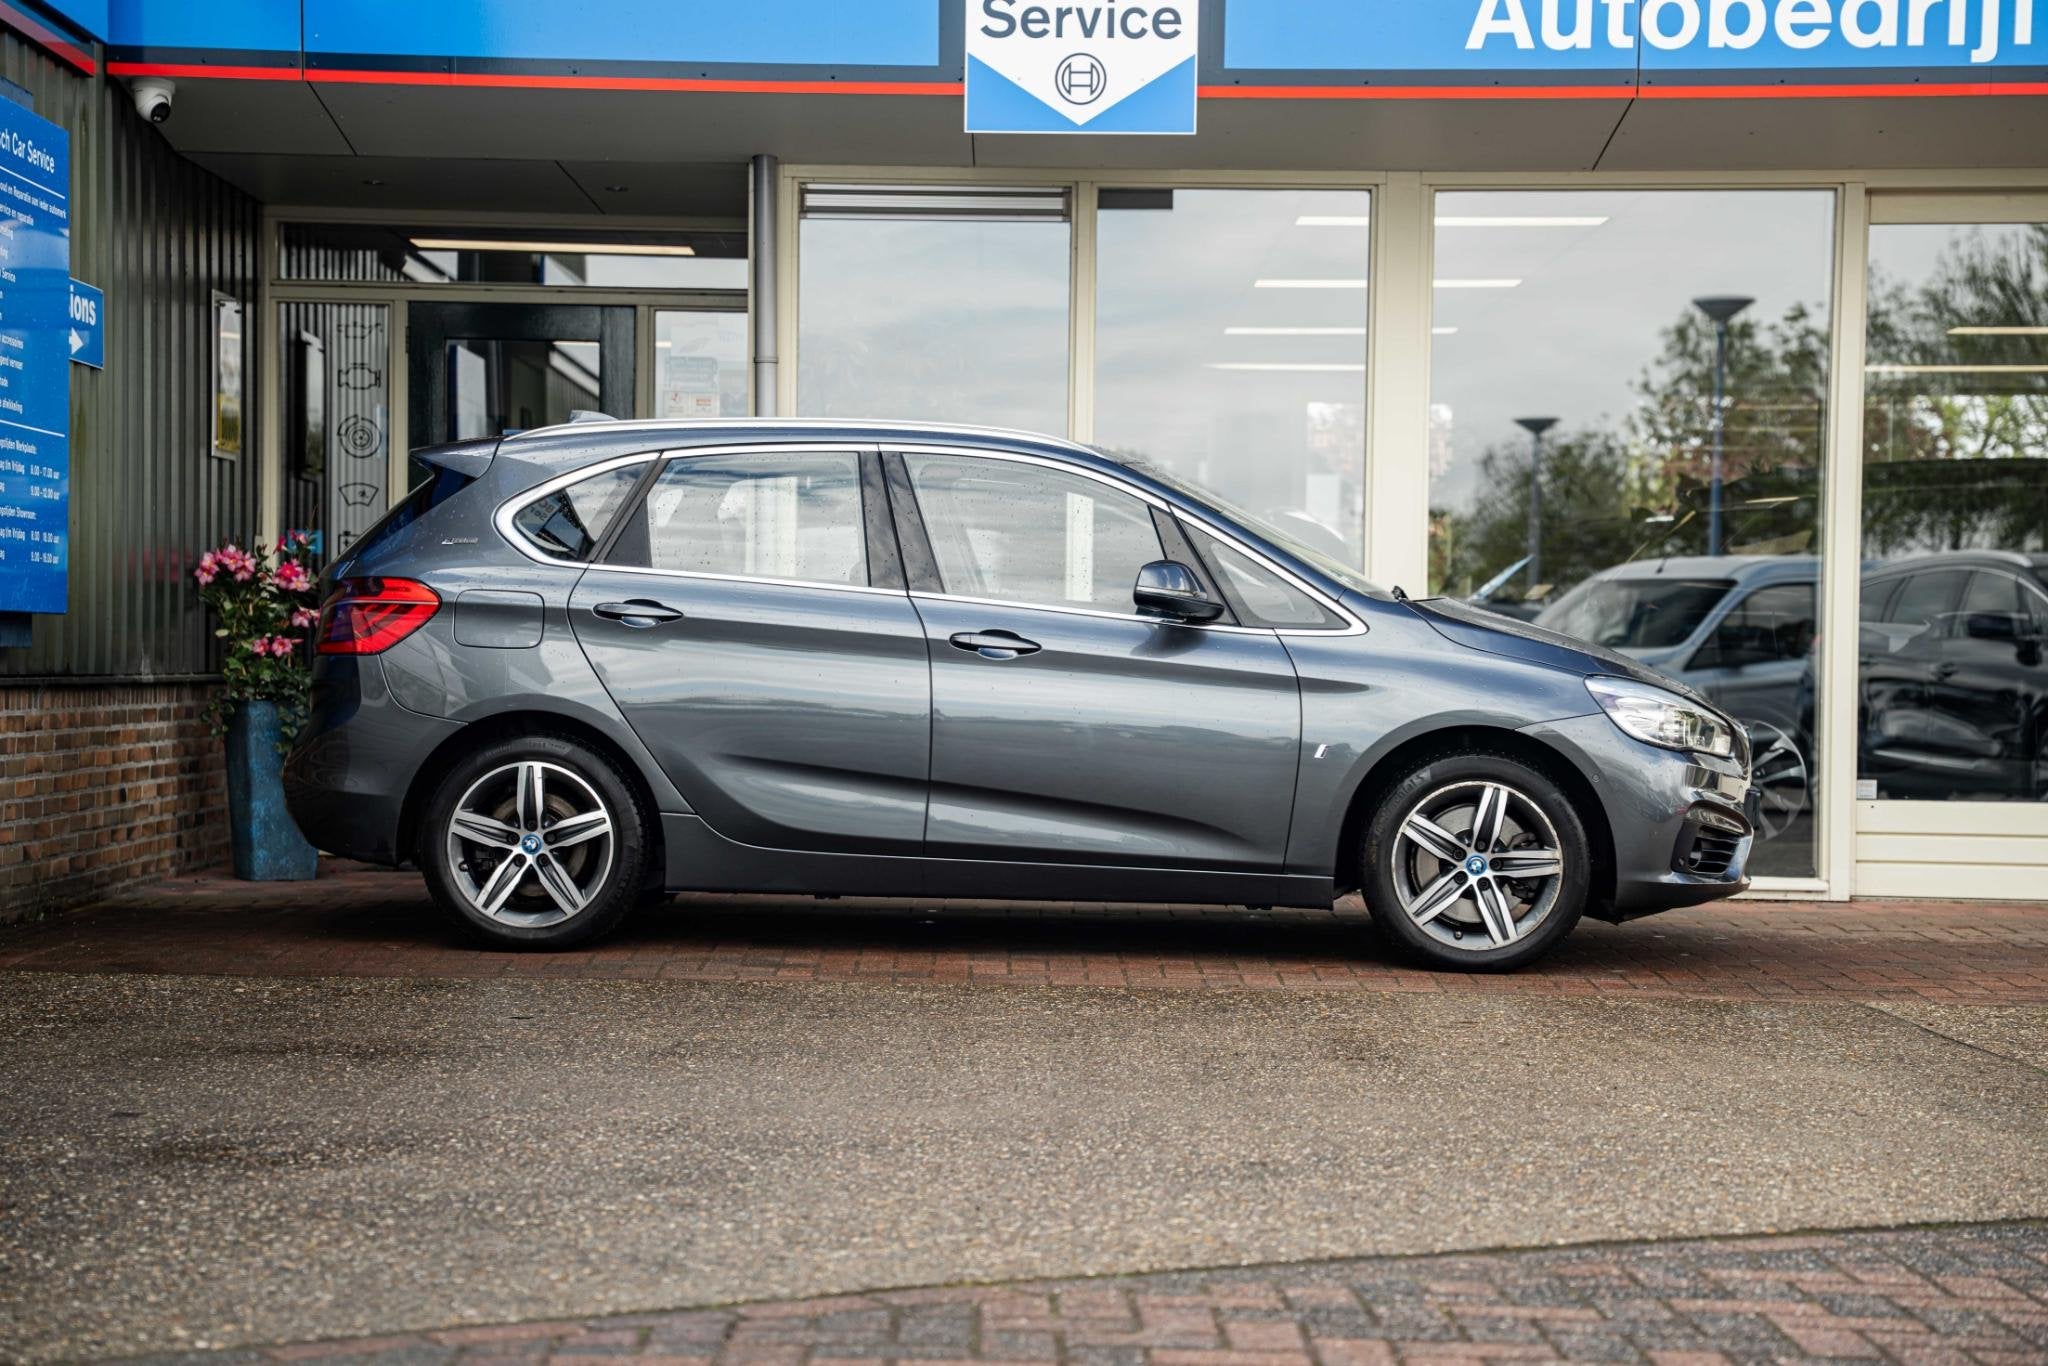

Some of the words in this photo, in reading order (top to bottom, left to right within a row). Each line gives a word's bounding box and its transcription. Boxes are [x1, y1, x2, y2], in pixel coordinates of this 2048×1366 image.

[980, 0, 1182, 39] Service
[12, 132, 26, 159] Car
[27, 139, 55, 174] Service
